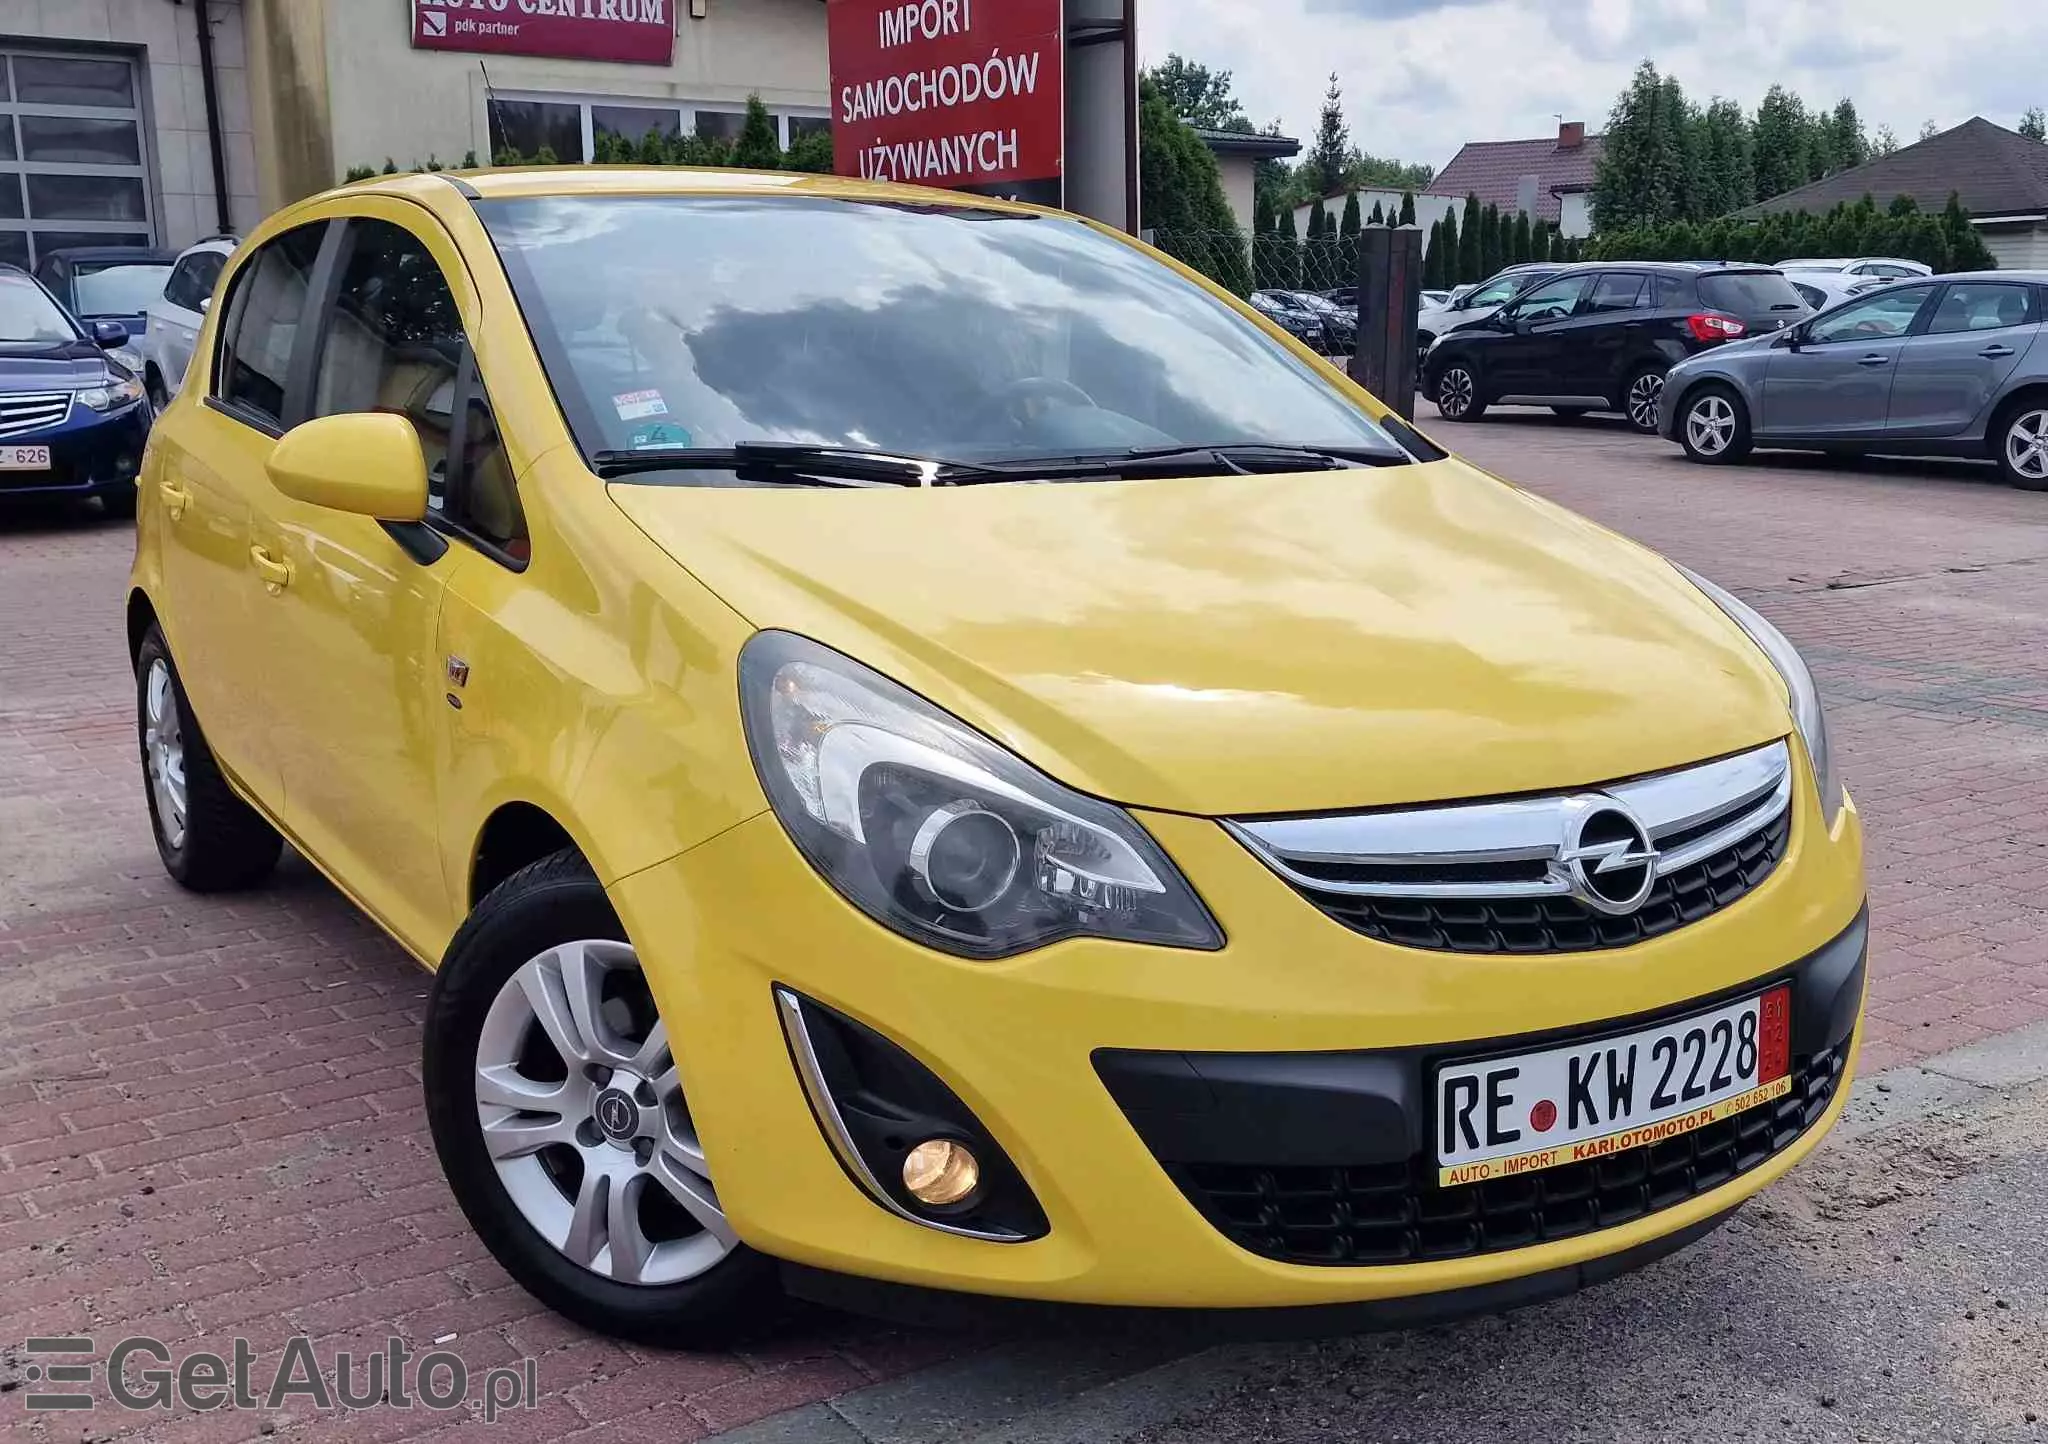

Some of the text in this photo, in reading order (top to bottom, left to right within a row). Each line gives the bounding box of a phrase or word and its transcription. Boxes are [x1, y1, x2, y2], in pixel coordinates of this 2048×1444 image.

[455, 19, 519, 35] pdk partner
[842, 48, 1039, 123] SAMOCHODÓW
[859, 129, 1018, 183] UŻYWANYCH
[1444, 1010, 1757, 1154] RE KW 2228
[1449, 1164, 1490, 1184] AUTO
[1504, 1150, 1558, 1174] IMPORT
[1573, 1109, 1716, 1160] KARI.OTOMOTO.PL
[1735, 1094, 1751, 1112] 502
